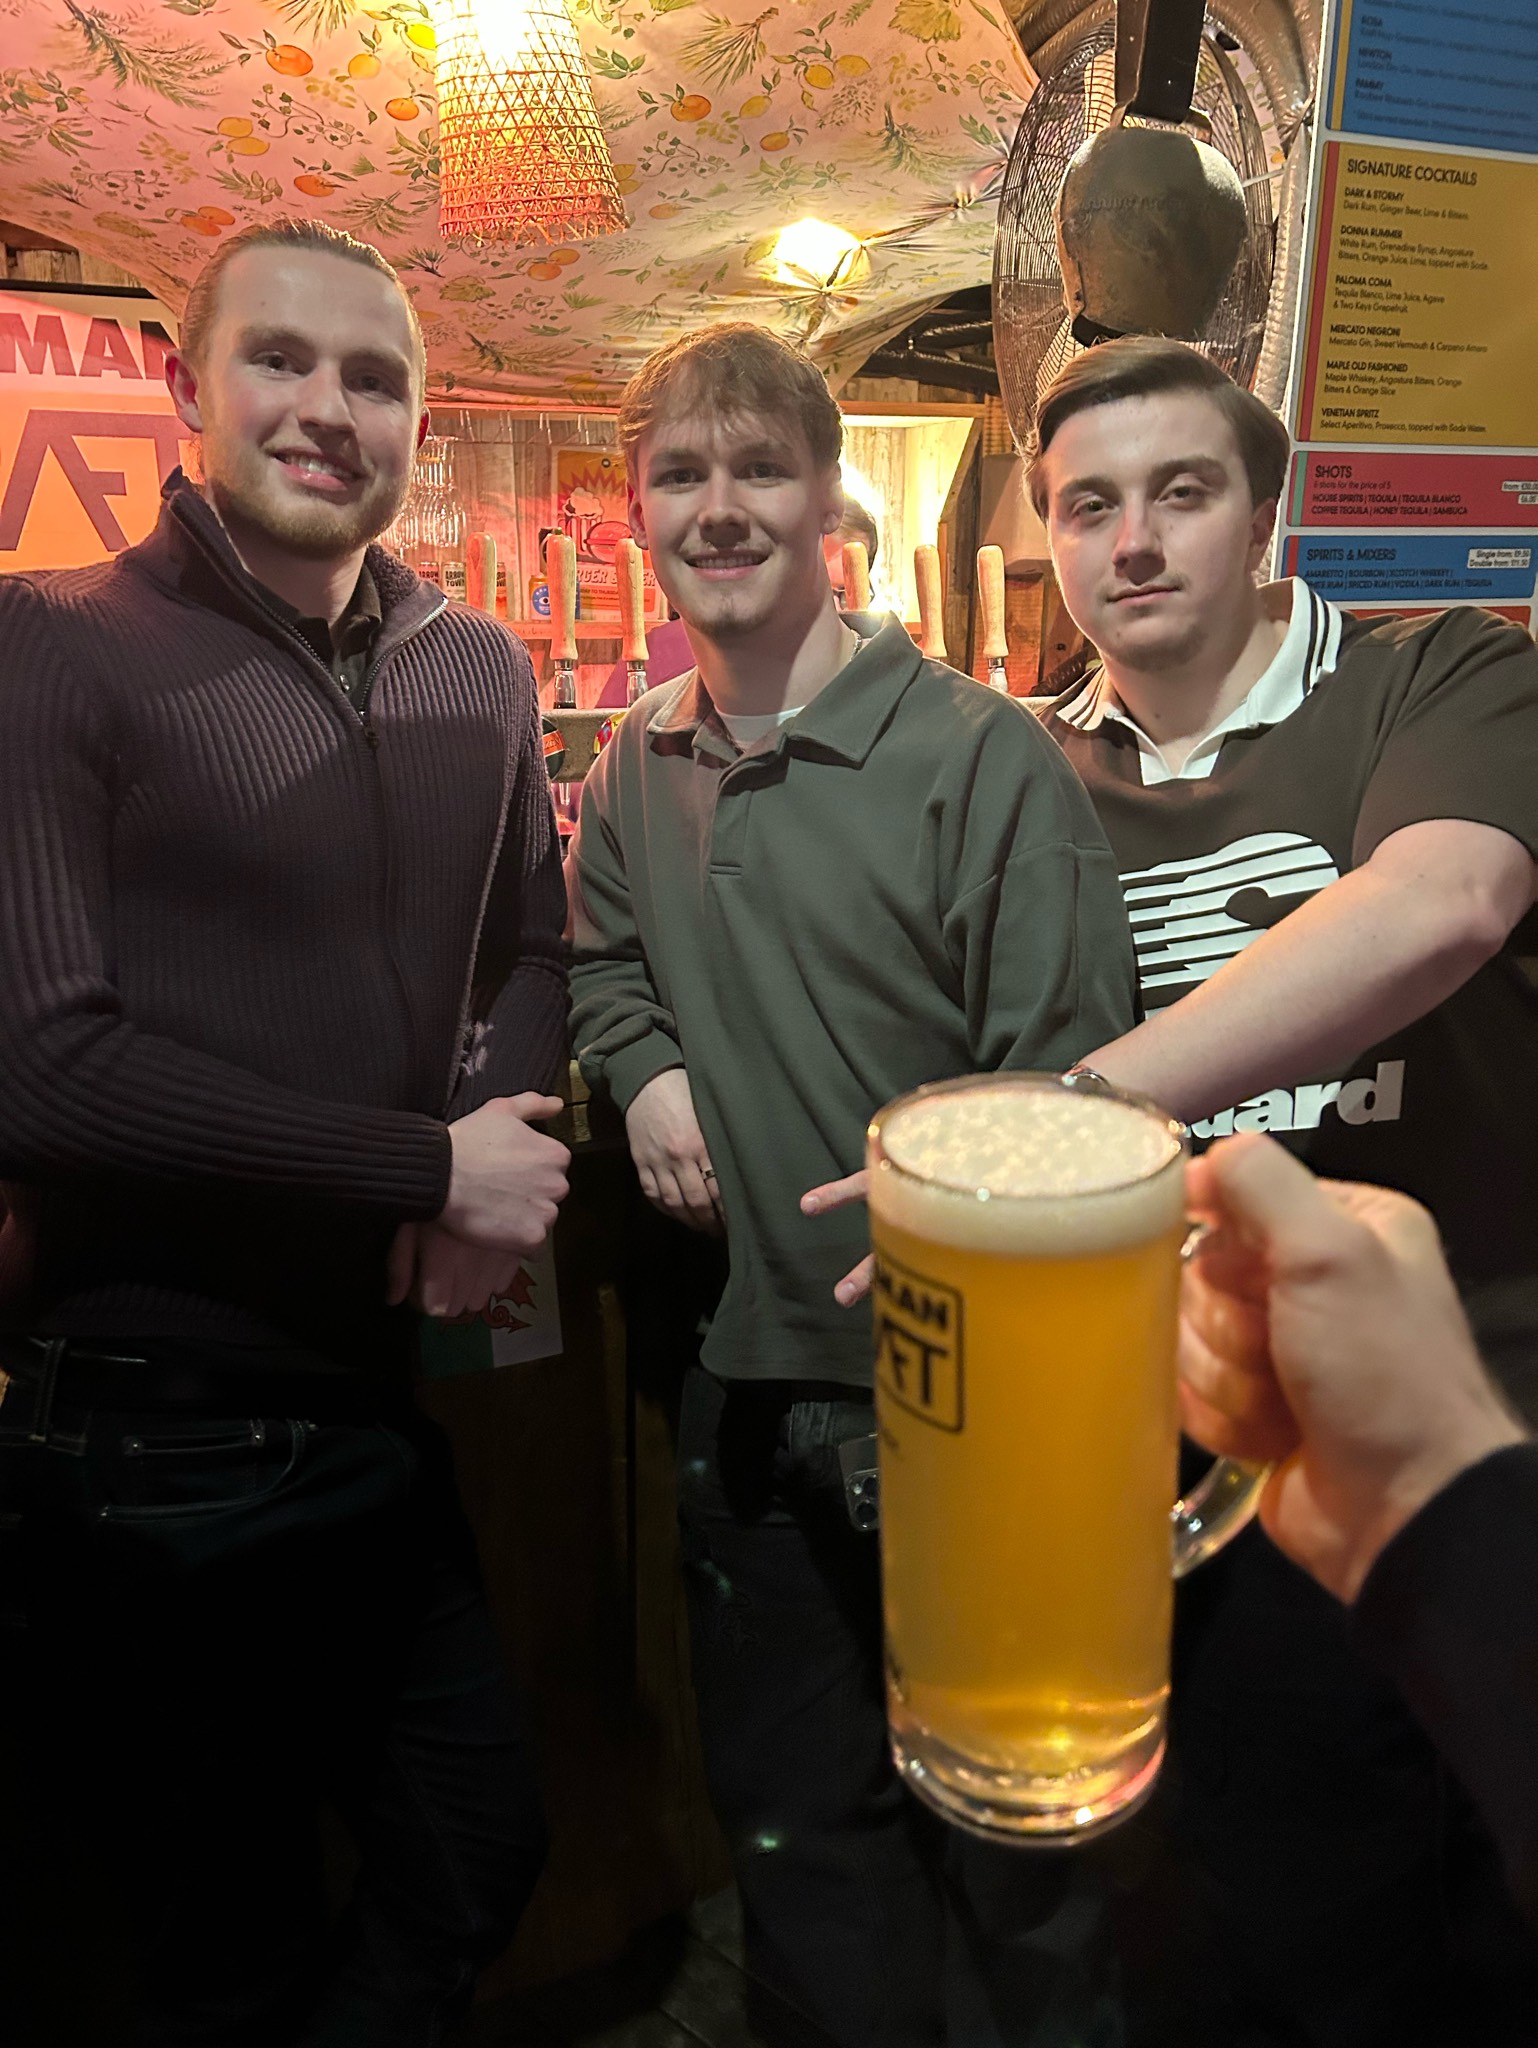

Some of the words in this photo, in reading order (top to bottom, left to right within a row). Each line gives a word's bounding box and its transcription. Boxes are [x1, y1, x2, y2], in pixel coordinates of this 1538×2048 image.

[1348, 159, 1411, 179] SIGNATURE
[1415, 166, 1477, 186] COCKTAILS
[1345, 187, 1365, 198] DARK
[1366, 190, 1371, 198] &
[1373, 190, 1404, 200] STORMY
[1344, 200, 1360, 210] Dark
[1380, 204, 1403, 216] Ginger
[1424, 208, 1439, 218] Lime
[1341, 225, 1369, 236] DONNA
[1371, 227, 1402, 239] RUMMER
[1340, 239, 1359, 248] White
[1380, 242, 1416, 254] Grenadine
[1363, 253, 1388, 264] Orange
[1429, 258, 1454, 269] topped
[1455, 260, 1469, 269] with
[1335, 275, 1366, 285] PALOMA
[1369, 277, 1392, 287] COMA
[1335, 288, 1358, 298] Tequila
[1386, 291, 1401, 301] Lime
[1341, 301, 1353, 310] Two
[1355, 302, 1371, 312] Keys
[1331, 324, 1365, 335] MERCATO
[1367, 326, 1400, 337] NEGRONI
[1329, 337, 1357, 347] Mercato
[1327, 361, 1350, 370] MAPLE
[1352, 362, 1366, 370] OLD
[1368, 362, 1408, 372] FASHIONED
[1326, 373, 1346, 382] Maple
[1353, 386, 1378, 396] Orange
[1322, 408, 1355, 417] VENETIAN
[1357, 409, 1379, 418] SPRITZ
[1315, 465, 1352, 478] SHOTS
[1369, 494, 1397, 502] TEQUILA
[1340, 506, 1368, 514] TEQUILA
[1373, 506, 1398, 514] HONEY
[1307, 548, 1344, 561] SPIRITS
[1347, 548, 1354, 560] &
[1357, 548, 1397, 560] MIXERS
[576, 568, 608, 584] RGER
[1184, 1060, 1405, 1139] uard
